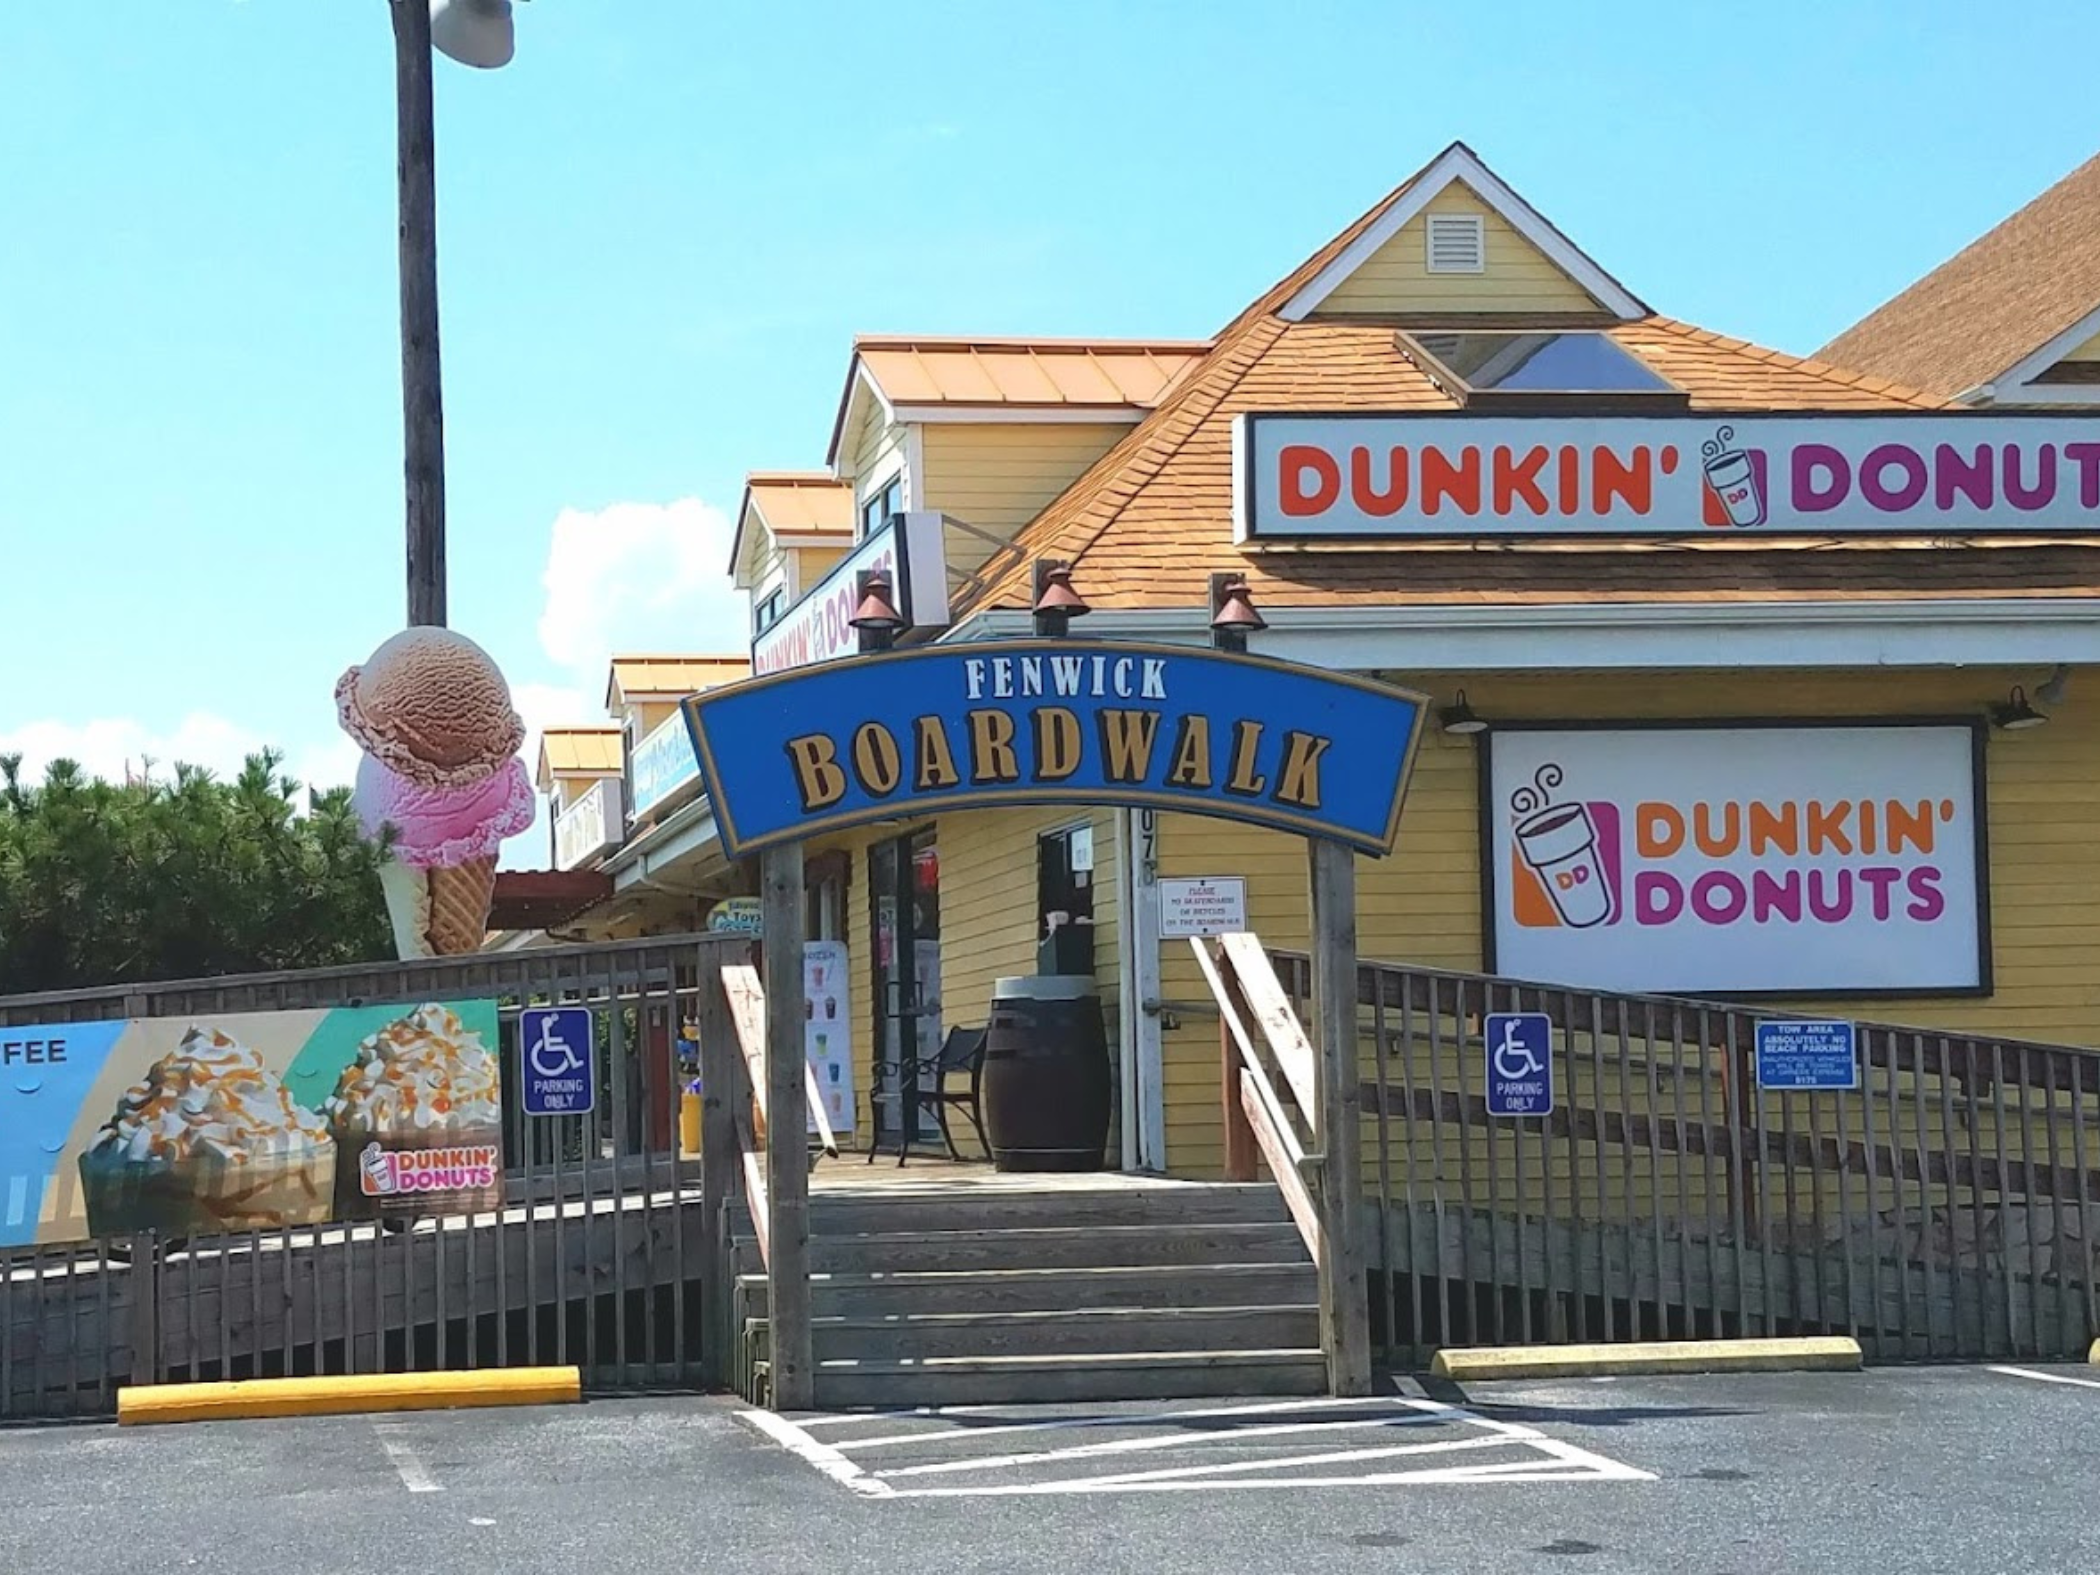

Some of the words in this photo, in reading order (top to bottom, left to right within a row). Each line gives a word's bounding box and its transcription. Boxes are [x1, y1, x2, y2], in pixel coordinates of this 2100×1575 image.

[1278, 444, 1679, 517] DUNKIN'
[964, 656, 1167, 699] FENWICK
[784, 705, 1331, 810] BOARDWALK
[1554, 864, 1589, 890] DD
[1636, 799, 1955, 858] DUNKIN'
[1634, 865, 1945, 925] DONUTS
[1764, 1035, 1828, 1043] ABSOLUTELY
[1833, 1035, 1846, 1043] NO
[1778, 1026, 1801, 1034] TOW
[1806, 1026, 1834, 1034] AREA
[0, 1040, 67, 1065] FEE
[1765, 1044, 1797, 1053] BEACH
[1802, 1044, 1846, 1053] PARKING
[534, 1079, 584, 1094] PARKING
[1496, 1082, 1543, 1096] PARKING
[543, 1094, 575, 1109] ONLY
[1506, 1097, 1535, 1110] ONLY
[399, 1147, 496, 1171] DUNKIN'
[399, 1167, 491, 1190] DONUTS
